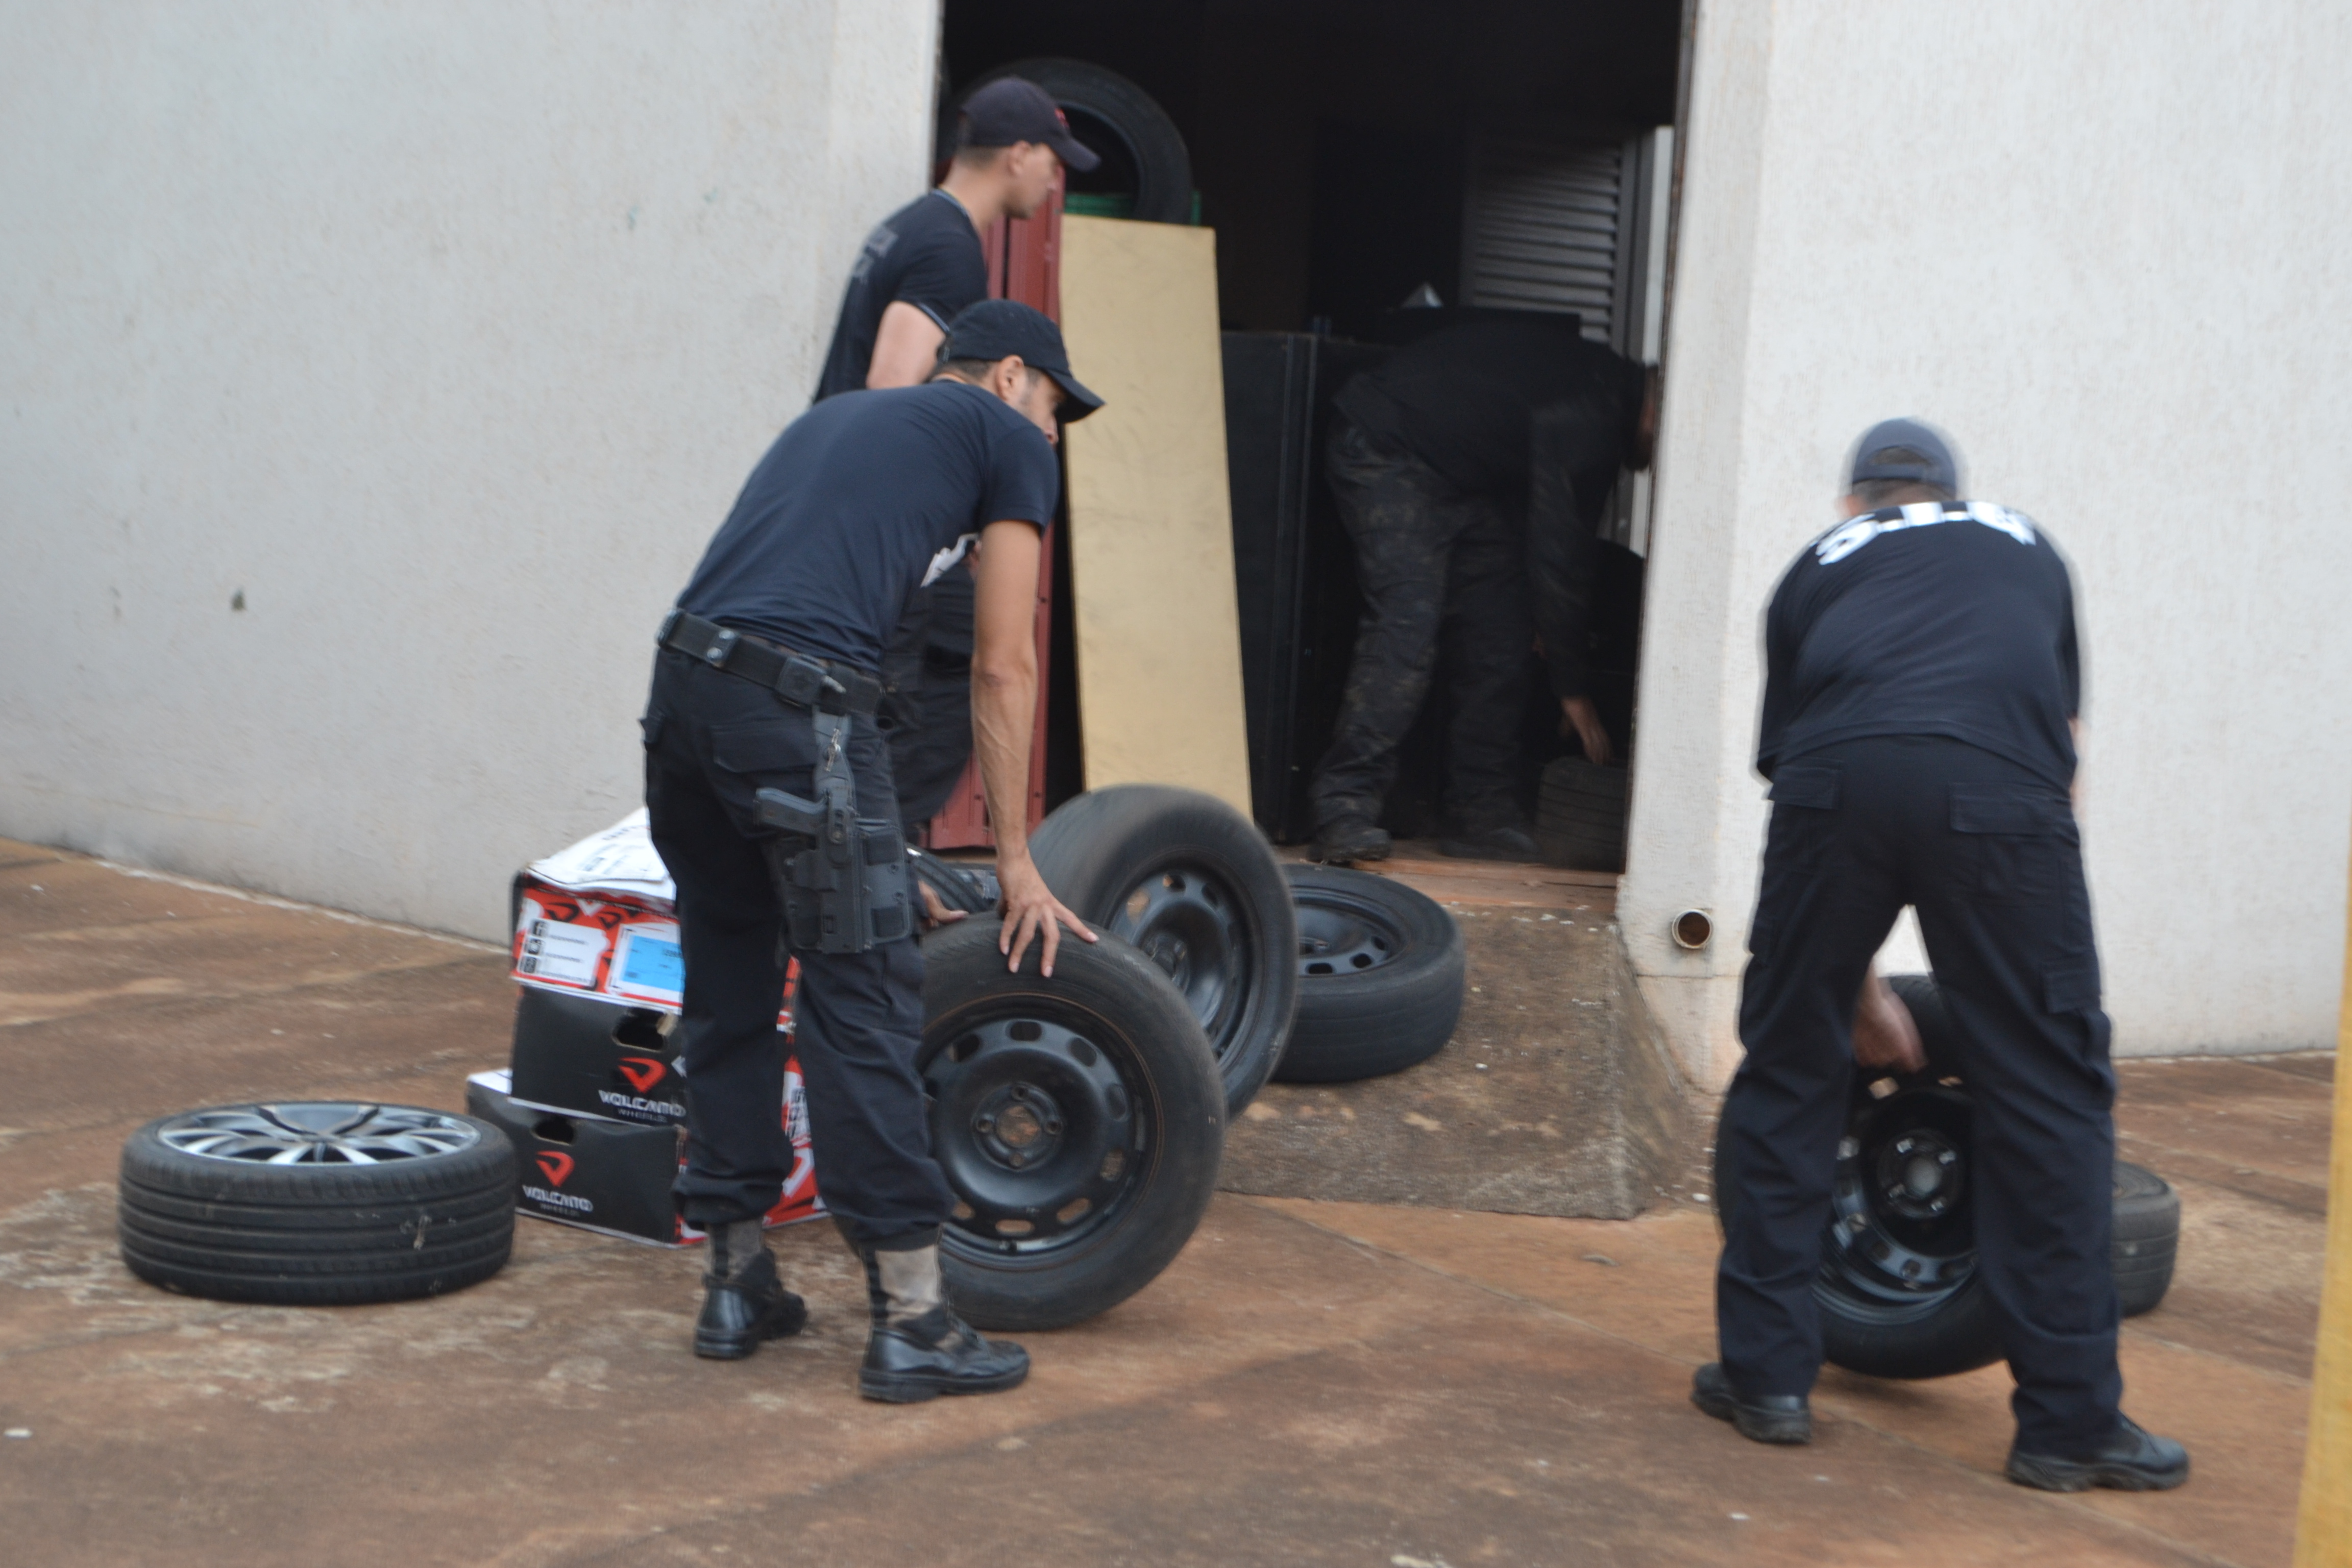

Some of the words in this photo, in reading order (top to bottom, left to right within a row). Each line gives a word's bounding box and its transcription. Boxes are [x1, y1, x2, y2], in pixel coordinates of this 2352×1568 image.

[598, 1089, 687, 1117] VOLCANO
[618, 1108, 667, 1123] WHEELS
[522, 1185, 594, 1212] VOLCANO
